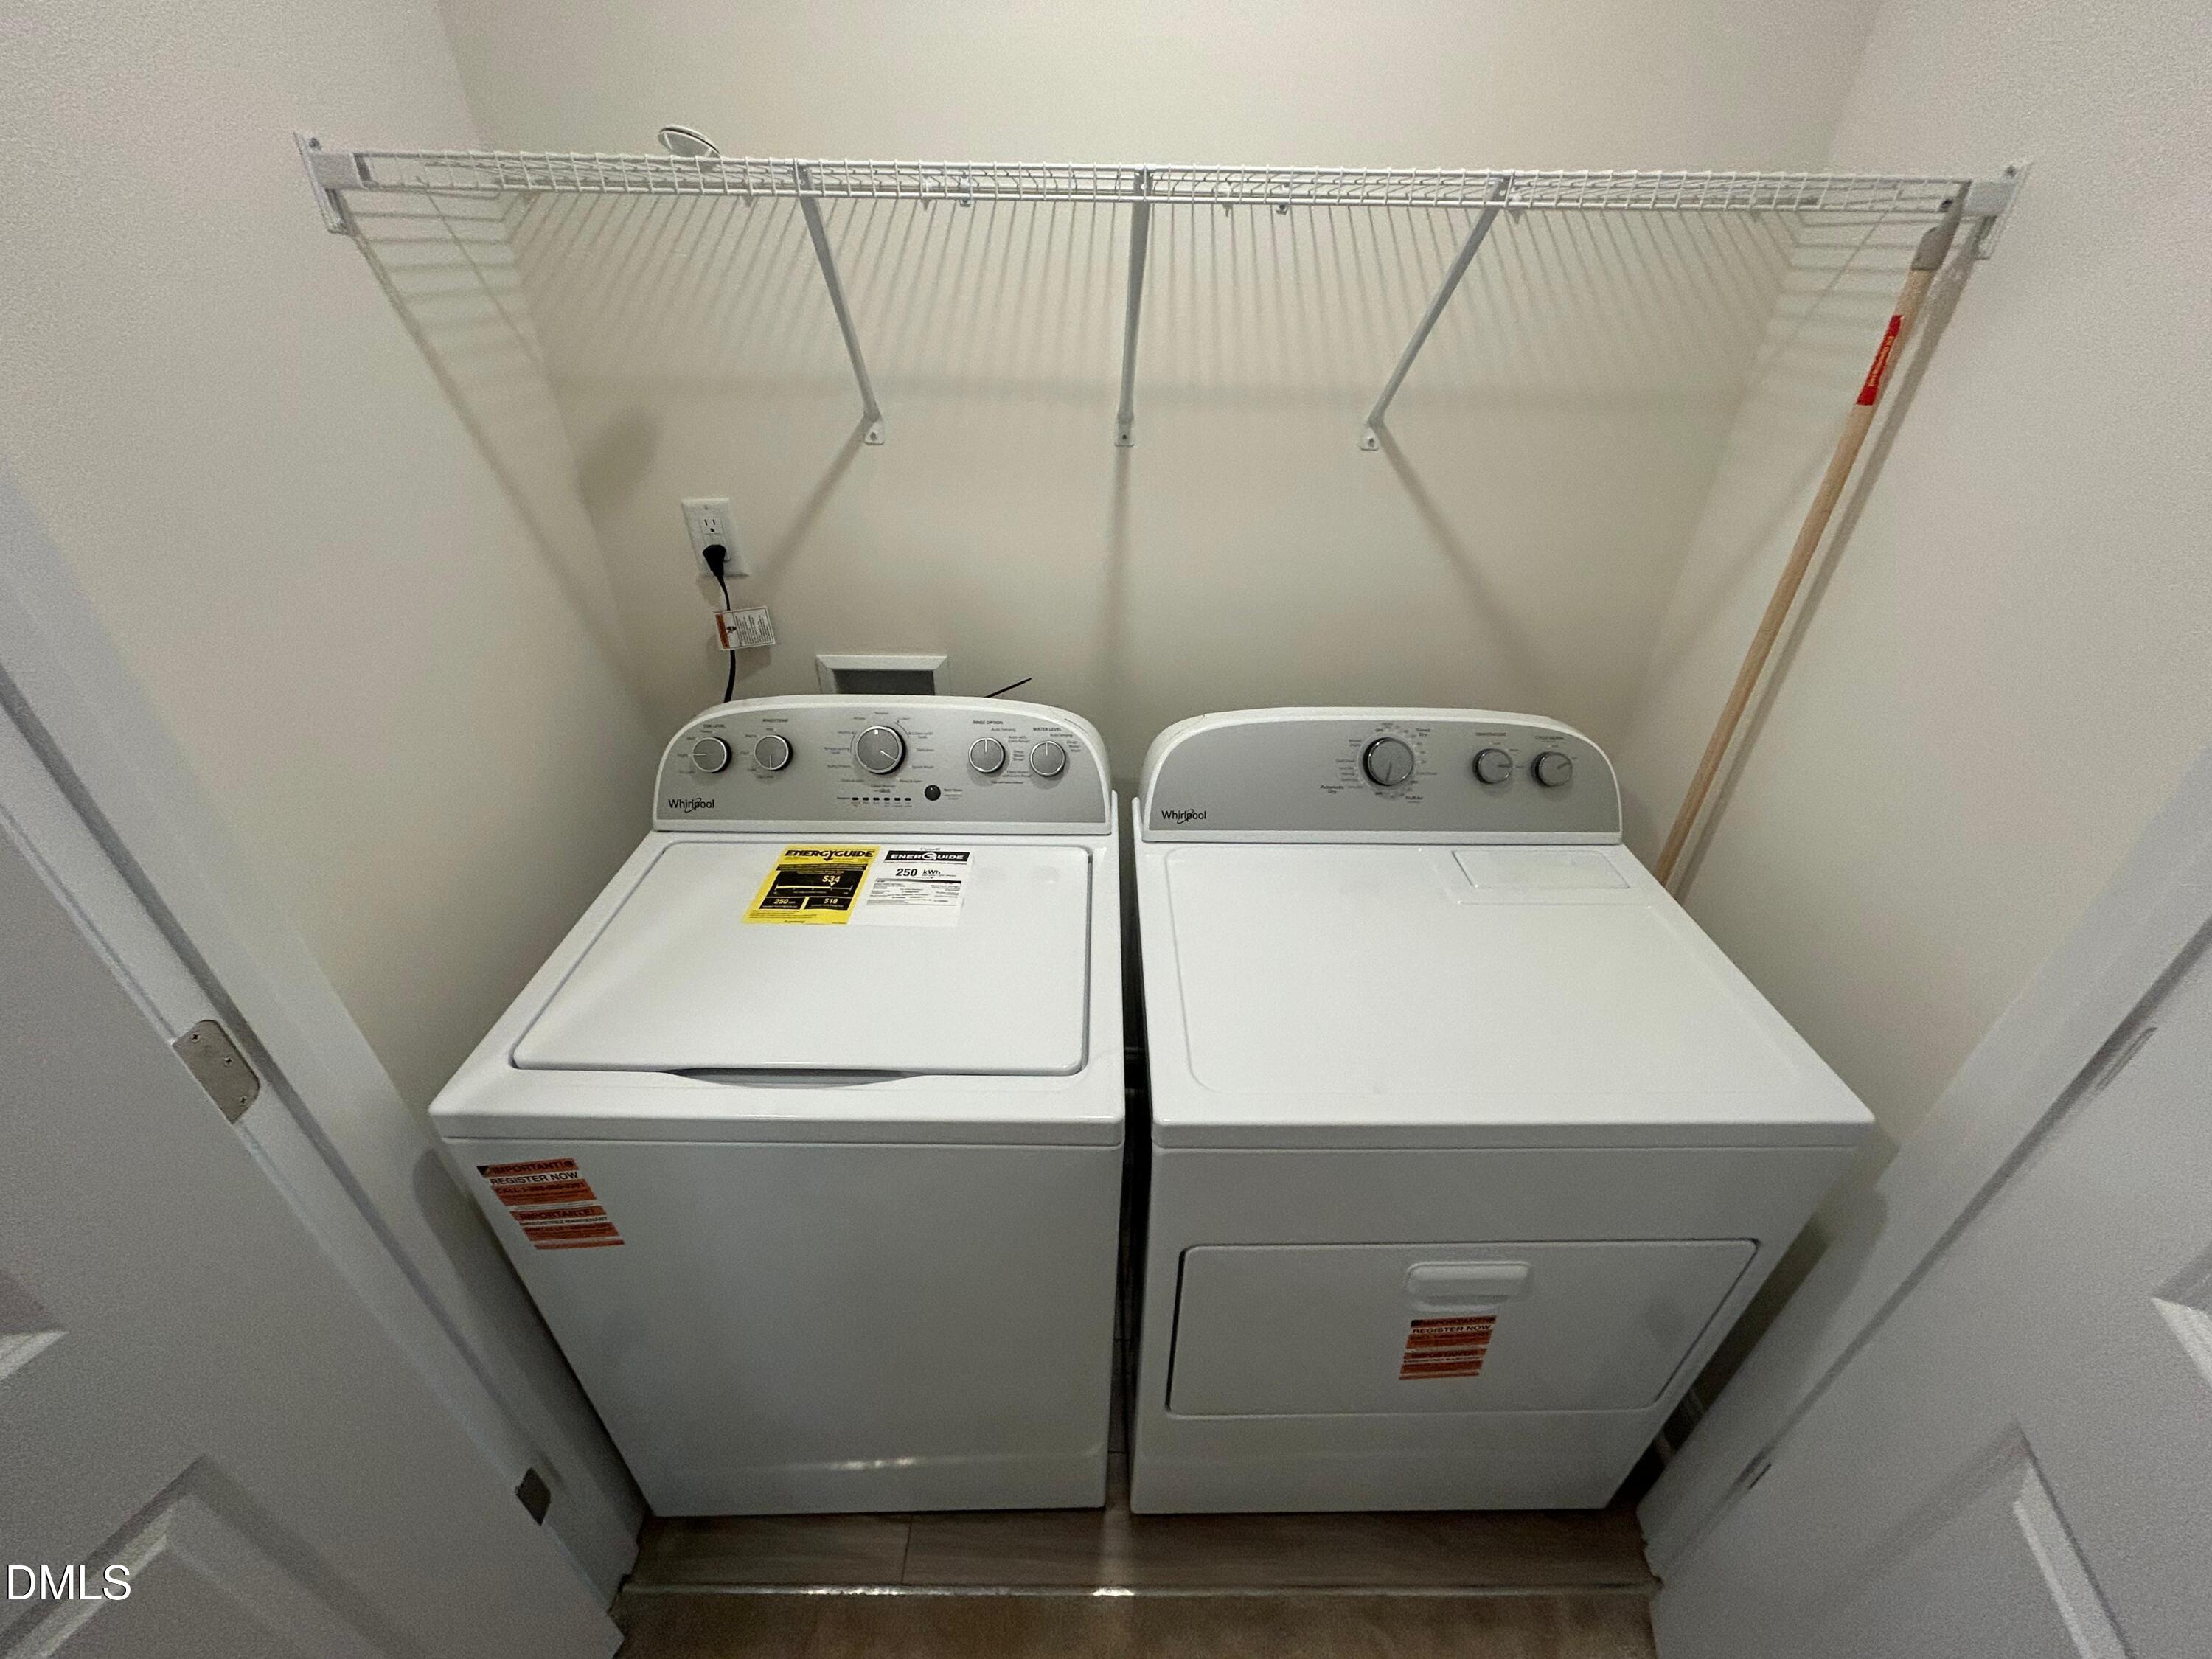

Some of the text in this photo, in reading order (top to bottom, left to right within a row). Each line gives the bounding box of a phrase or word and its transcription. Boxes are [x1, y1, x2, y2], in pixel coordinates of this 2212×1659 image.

[668, 798, 714, 812] Whirlpool
[1161, 809, 1207, 823] Whirlpool
[785, 849, 875, 858] ENERGYGUIDE
[890, 852, 965, 860] ENERGUIDE
[895, 868, 918, 877] 250
[490, 1171, 579, 1185] REGISTER NOW
